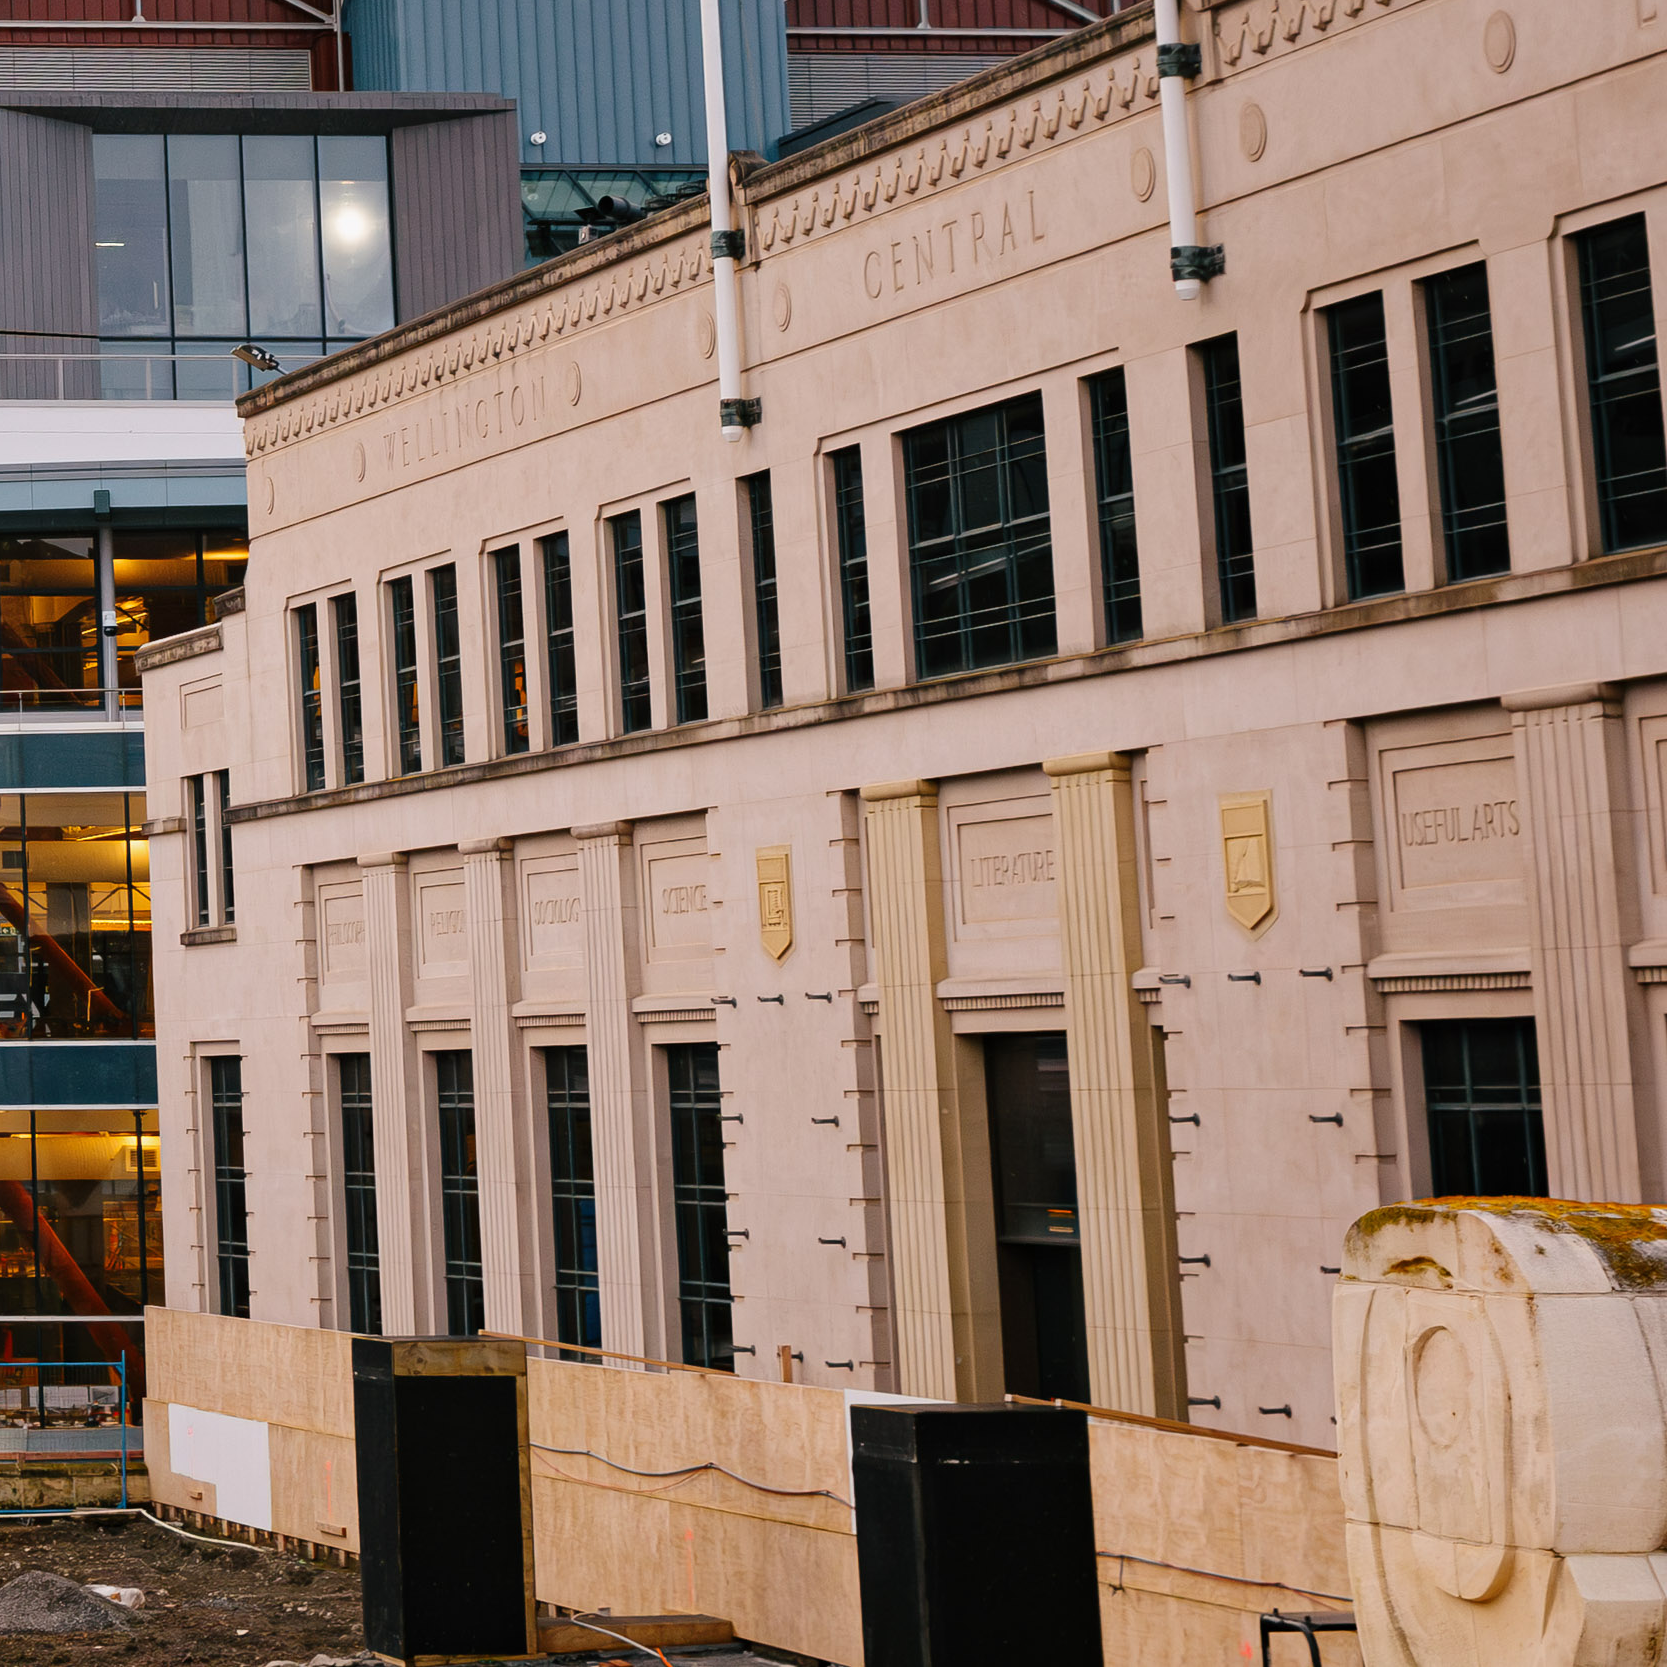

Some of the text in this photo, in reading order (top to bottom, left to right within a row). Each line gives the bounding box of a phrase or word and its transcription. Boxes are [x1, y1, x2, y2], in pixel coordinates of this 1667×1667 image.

[863, 190, 1047, 301] CENTRAL
[382, 375, 547, 471] WELLINGTON
[1402, 800, 1521, 847] USEFUL ARTS
[970, 850, 1056, 888] LITERATURE
[662, 884, 708, 915] SCIENCE
